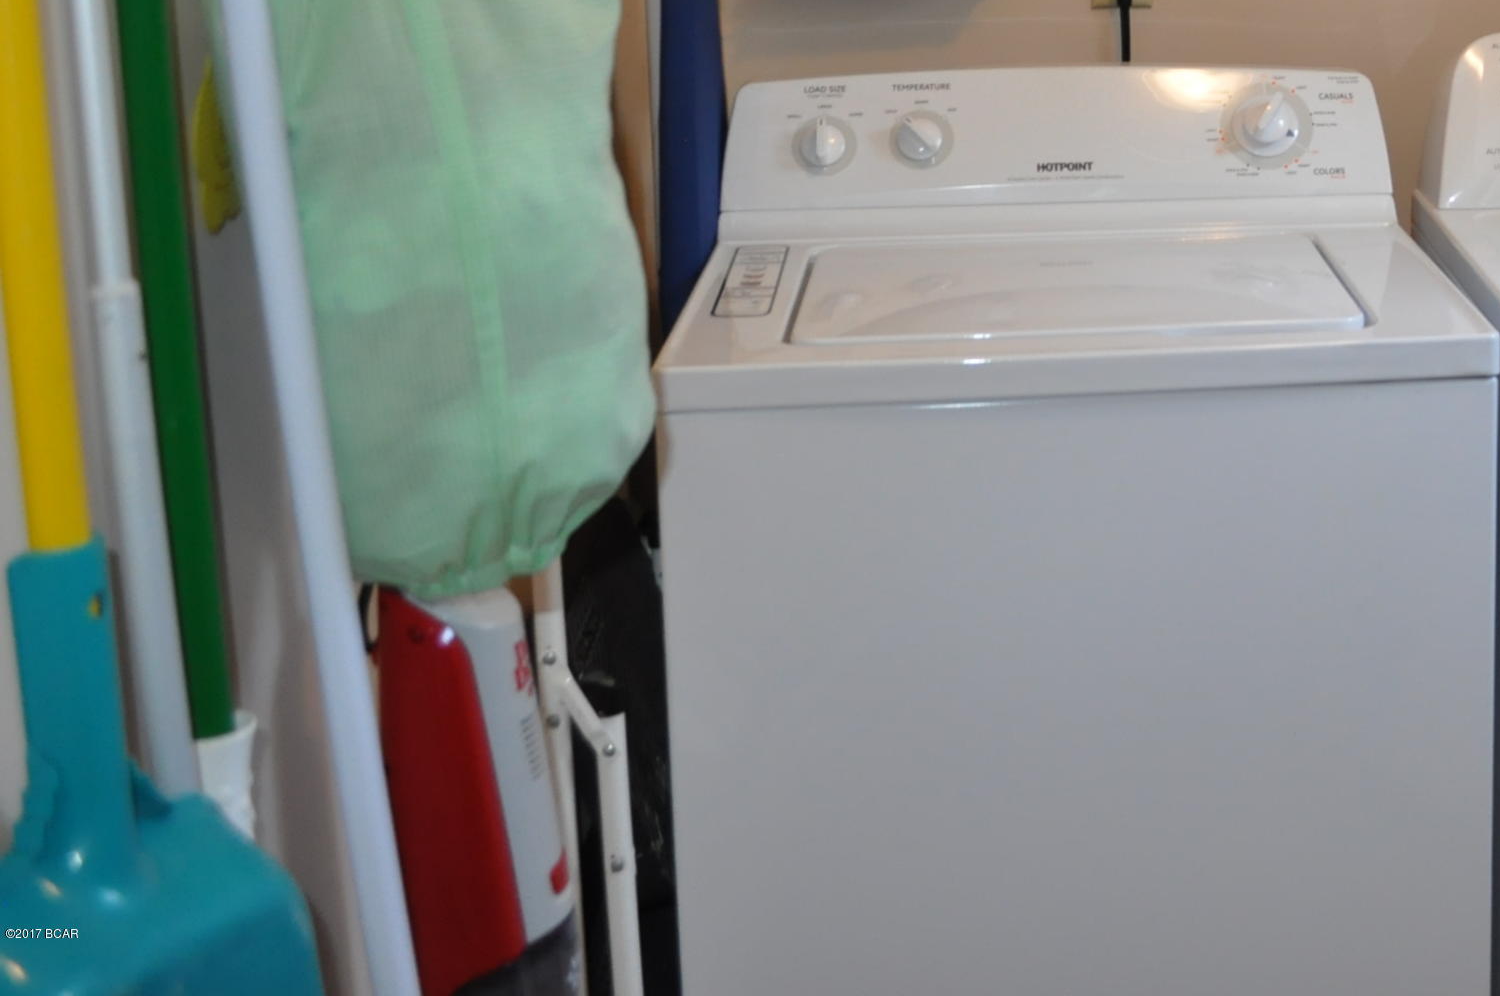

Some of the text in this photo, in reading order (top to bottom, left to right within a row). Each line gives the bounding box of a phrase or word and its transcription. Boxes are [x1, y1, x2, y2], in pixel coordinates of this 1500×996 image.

[804, 85, 847, 94] LOAD SIZE
[892, 83, 952, 92] TEMPERATURE
[1318, 93, 1354, 101] CASUALS
[1036, 161, 1094, 172] HOTPOINT
[1313, 167, 1345, 175] COLORS
